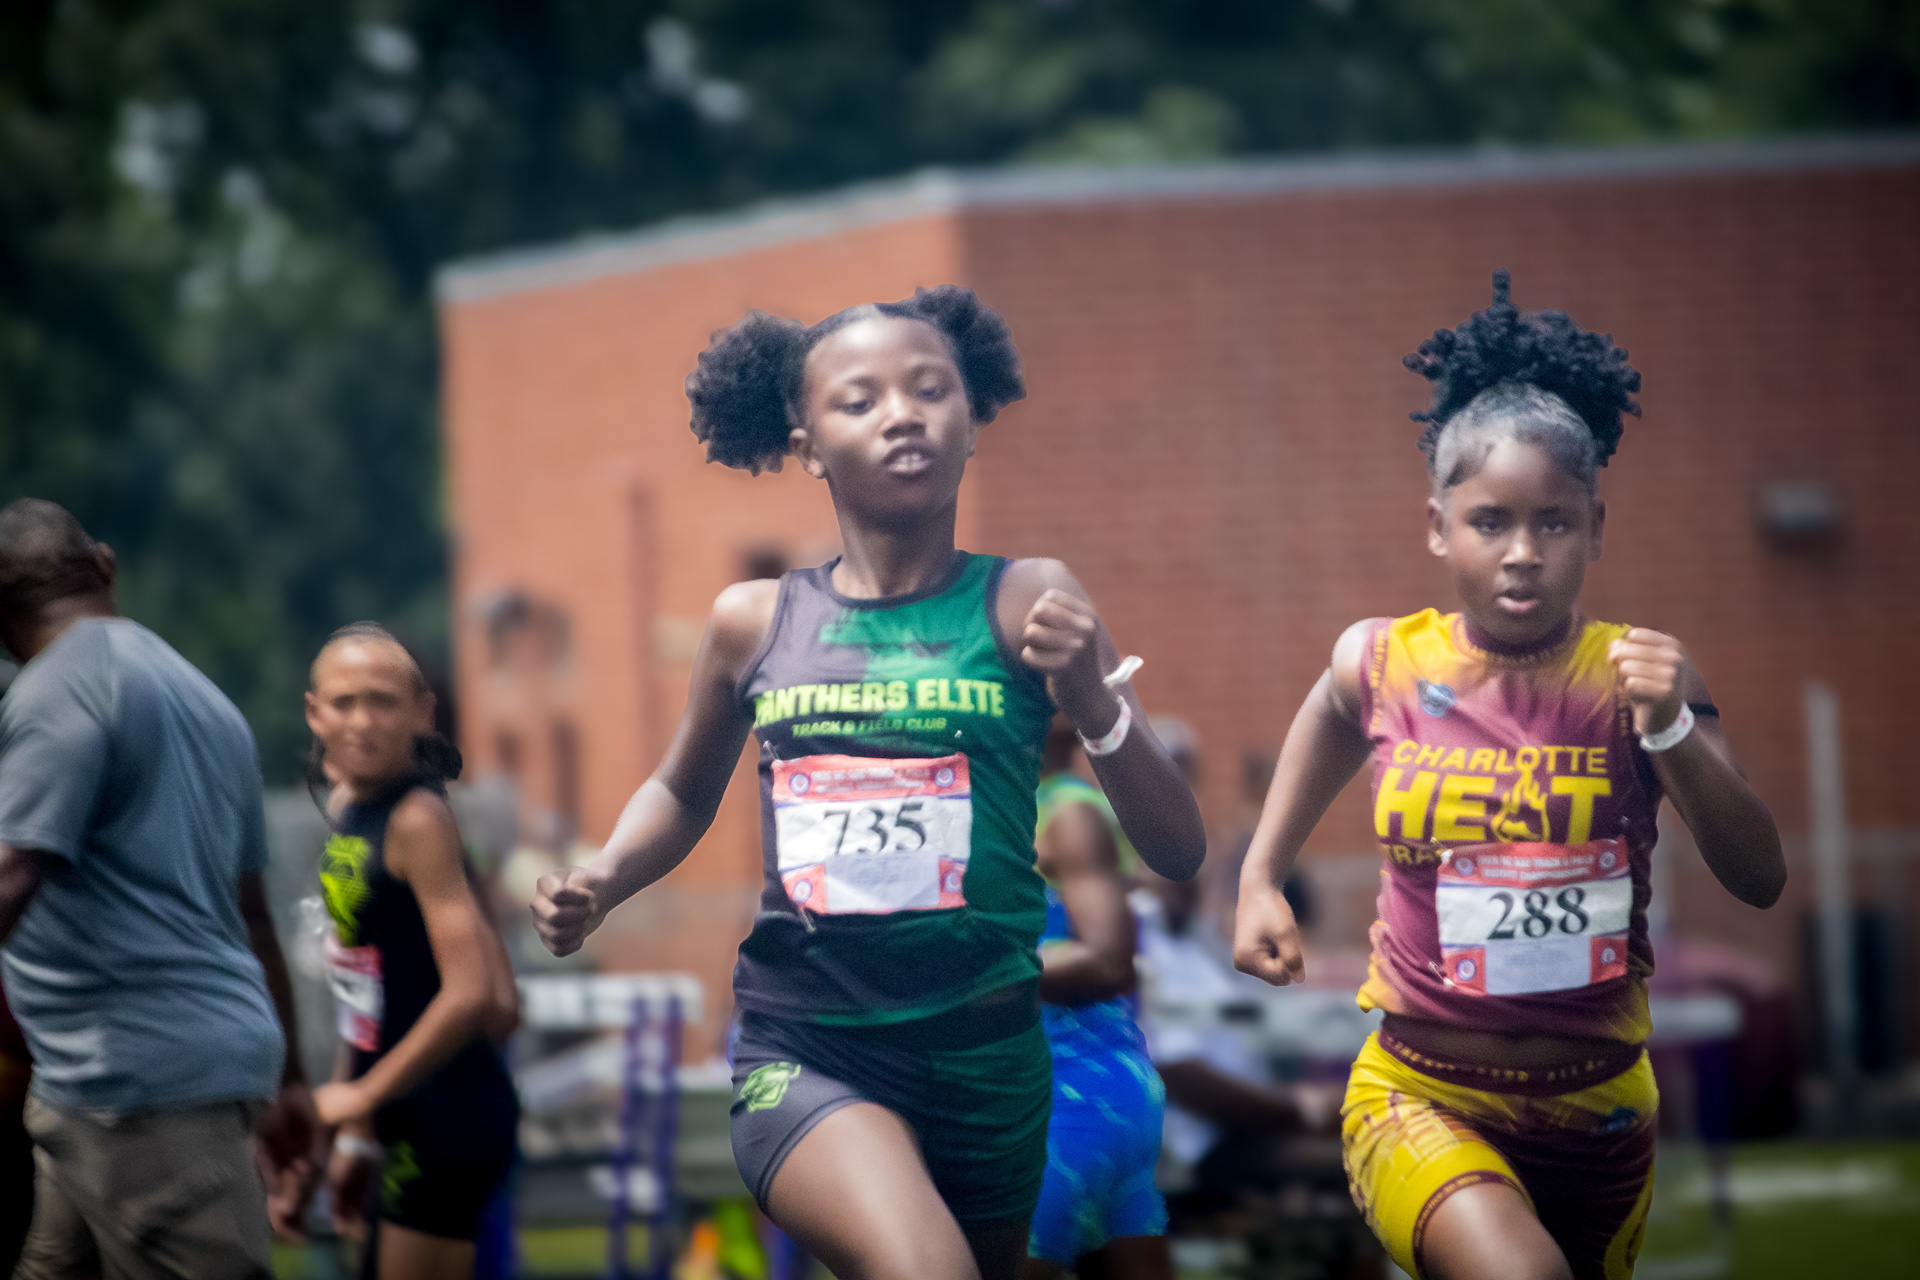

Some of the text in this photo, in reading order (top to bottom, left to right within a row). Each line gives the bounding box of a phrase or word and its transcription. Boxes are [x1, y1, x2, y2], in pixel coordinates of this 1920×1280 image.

[915, 679, 1004, 716] ELITE
[792, 720, 842, 737] TRACK
[857, 719, 903, 733] FIELD
[906, 717, 947, 731] CLUB
[1393, 740, 1608, 773] CHARLOTTE
[824, 801, 926, 855] 735
[1487, 887, 1589, 940] 288
